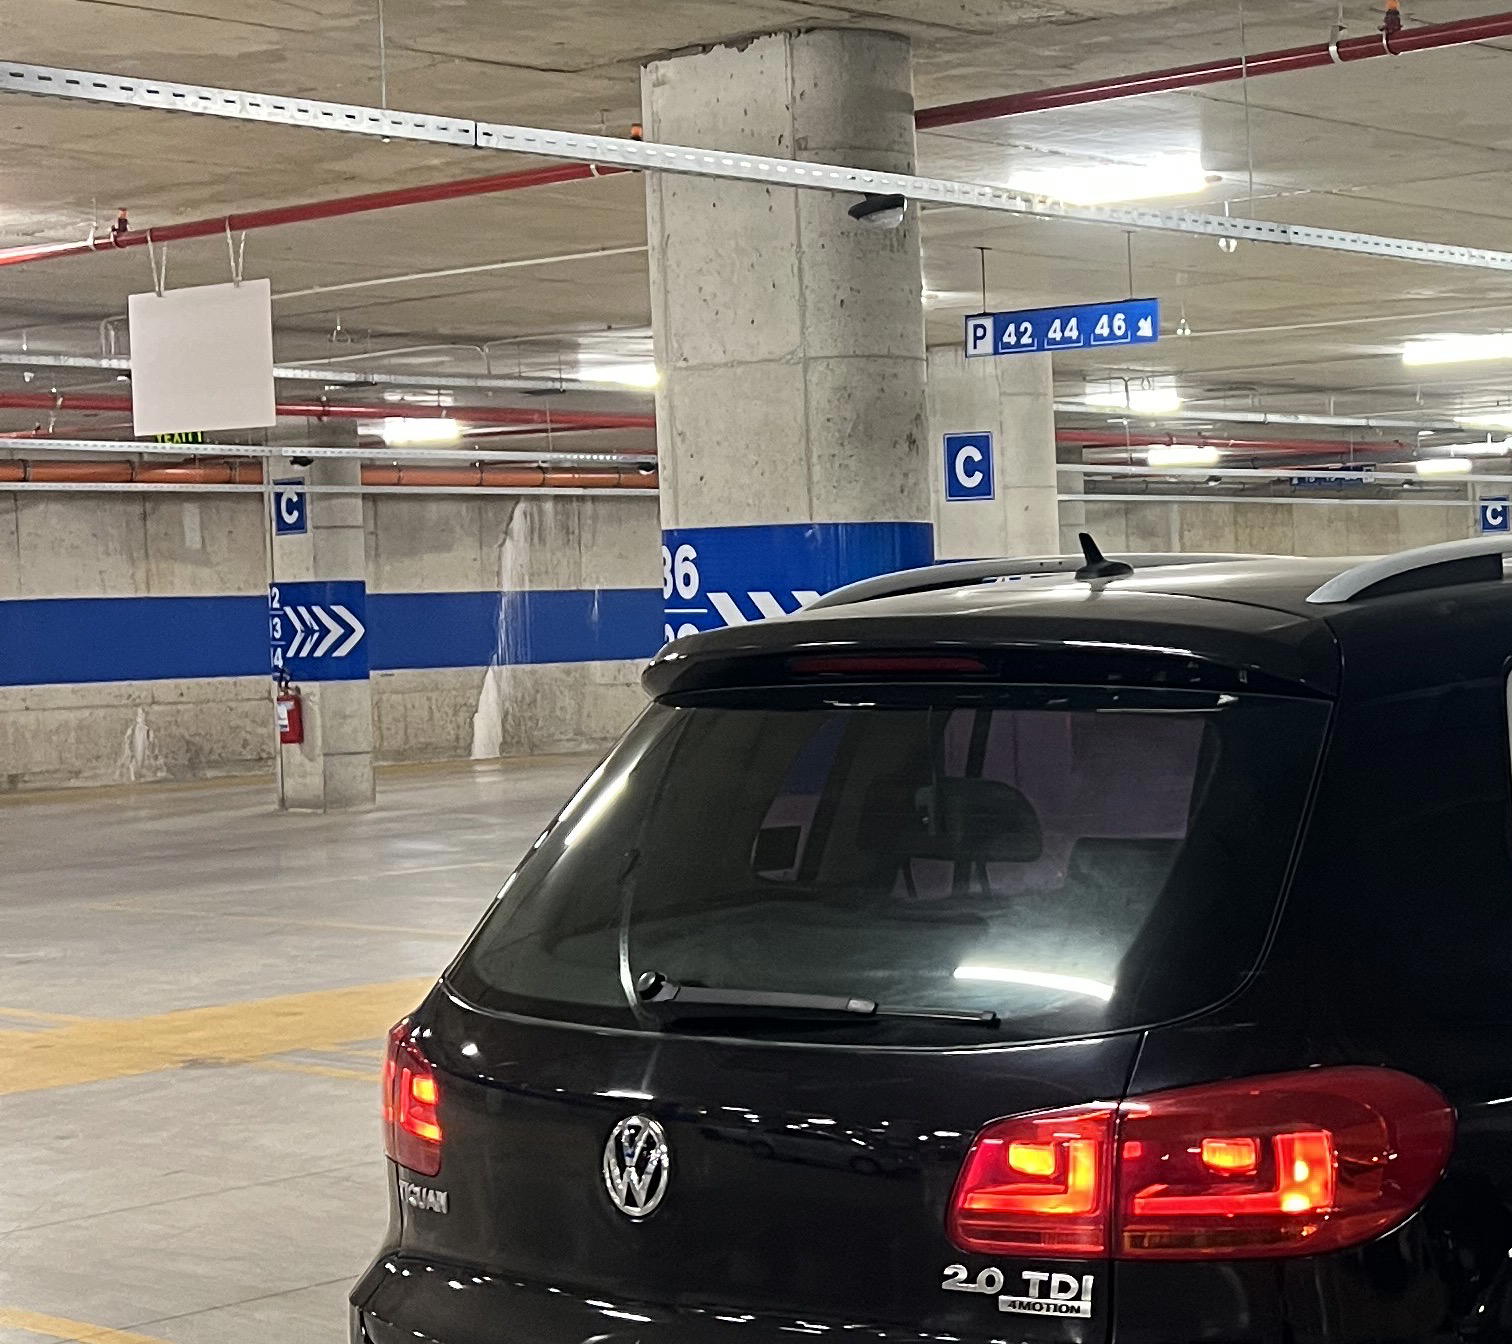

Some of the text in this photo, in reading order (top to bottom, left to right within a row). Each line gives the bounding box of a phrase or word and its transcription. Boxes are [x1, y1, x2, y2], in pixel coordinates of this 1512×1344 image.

[972, 313, 1126, 350] P 42 44 46
[955, 445, 984, 488] C
[280, 489, 299, 525] C
[1485, 504, 1503, 526] C
[941, 1264, 1095, 1301] 2.0 TDI
[1007, 1300, 1081, 1315] 4MOTION
